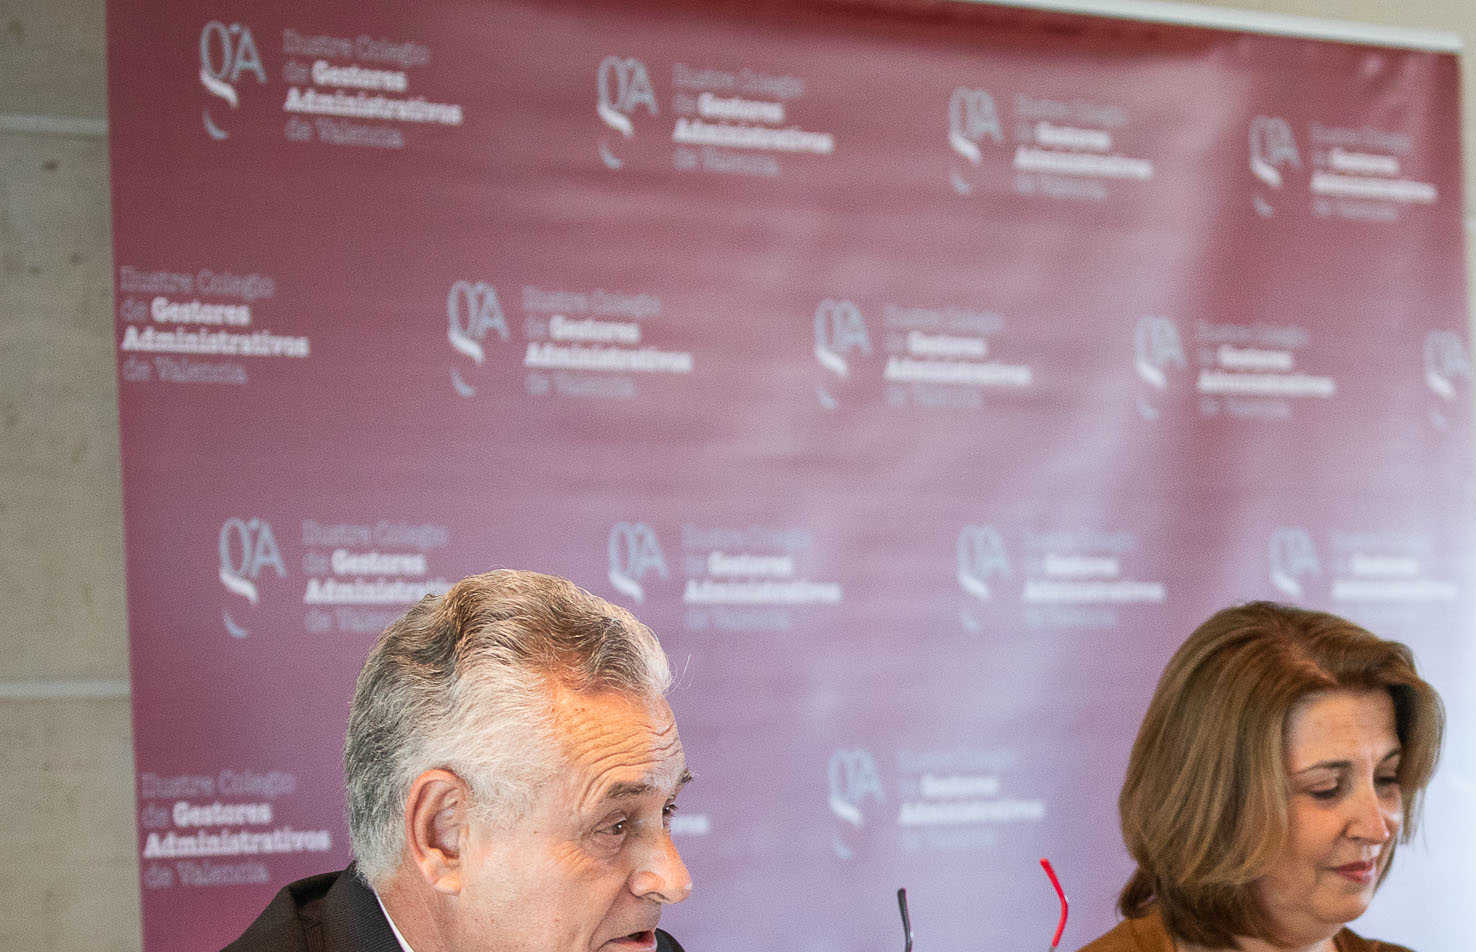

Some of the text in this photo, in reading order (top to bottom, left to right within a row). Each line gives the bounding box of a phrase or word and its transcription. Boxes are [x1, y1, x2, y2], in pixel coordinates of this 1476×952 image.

[312, 60, 407, 92] Gestores
[284, 87, 463, 126] Administrativos
[151, 297, 251, 326] Gestores
[121, 325, 310, 358] Administrativos
[332, 548, 427, 576] Gestores
[173, 801, 272, 827] Gestores
[143, 825, 332, 858] Administrativos
